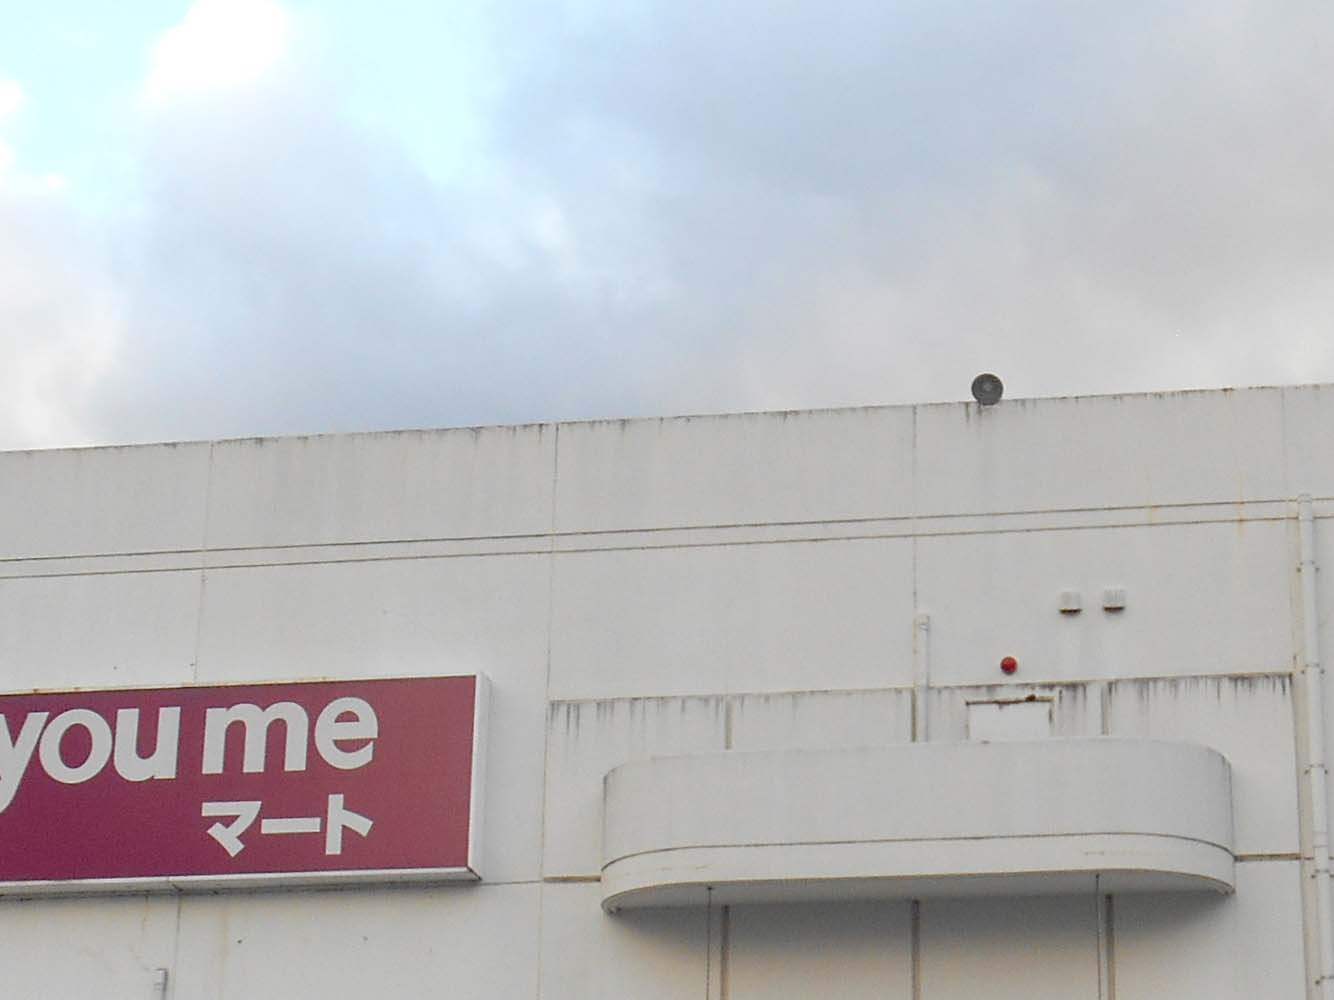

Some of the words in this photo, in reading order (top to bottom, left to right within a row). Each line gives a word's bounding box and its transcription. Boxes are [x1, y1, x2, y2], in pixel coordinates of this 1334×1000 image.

[202, 697, 379, 774] me
[201, 794, 374, 857] マート
